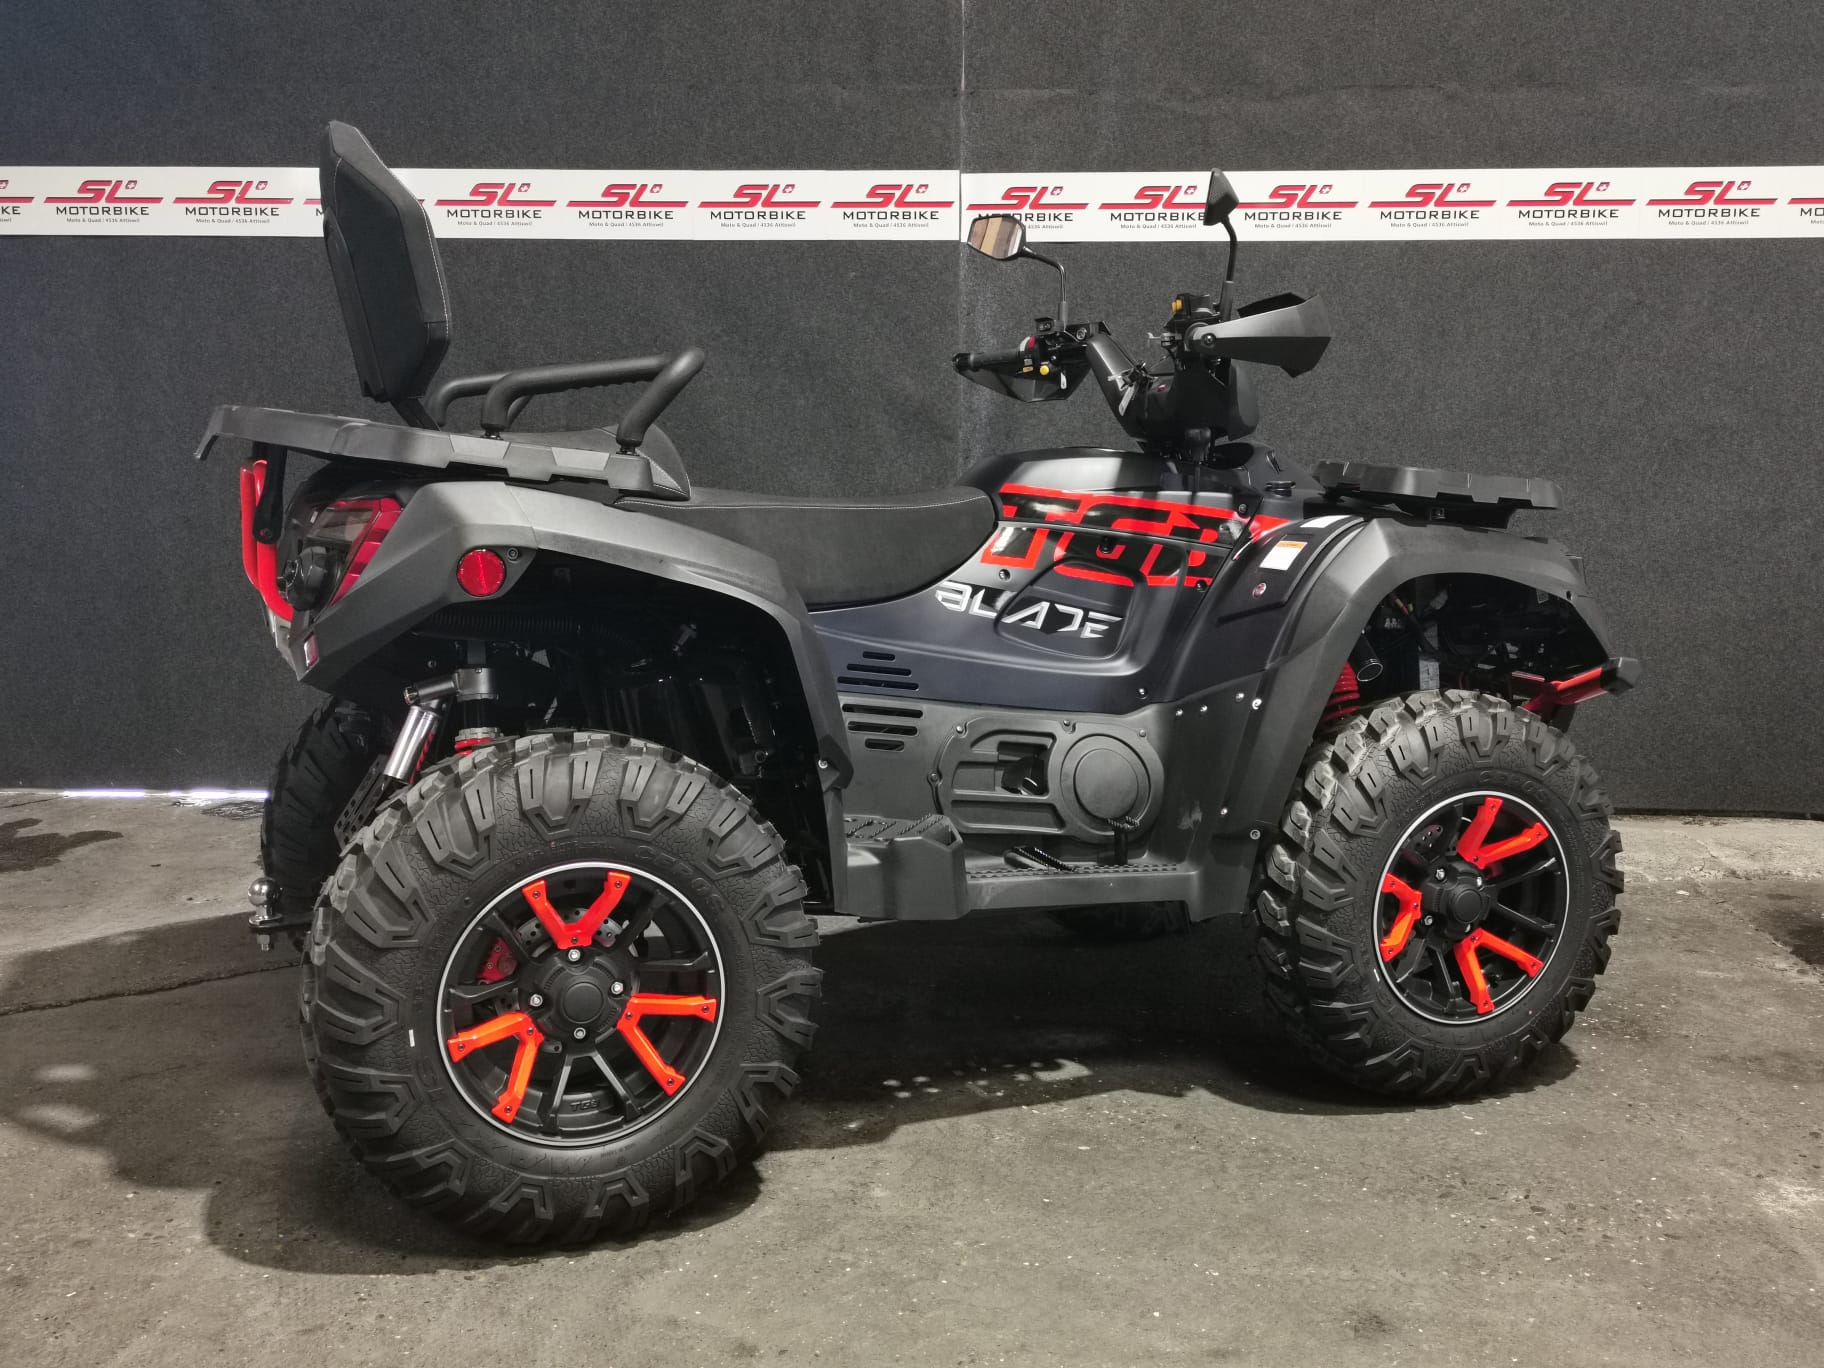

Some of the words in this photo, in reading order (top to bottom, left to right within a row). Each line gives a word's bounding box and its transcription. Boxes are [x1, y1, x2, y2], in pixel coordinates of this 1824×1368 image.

[56, 206, 149, 215] MOTORBIKE
[185, 206, 279, 216] MOTORBIKE
[447, 209, 542, 218] MOTORBIKE
[578, 210, 673, 219] MOTORBIKE
[710, 210, 806, 219] MOTORBIKE
[843, 210, 939, 220] MOTORBIKE
[1380, 210, 1480, 219] MOTORBIKE
[1518, 209, 1619, 218] MOTORBIKE
[1657, 208, 1760, 217] MOTORBIKE
[1244, 211, 1342, 220] MOTORBIKE
[935, 580, 1123, 639] BLADE
